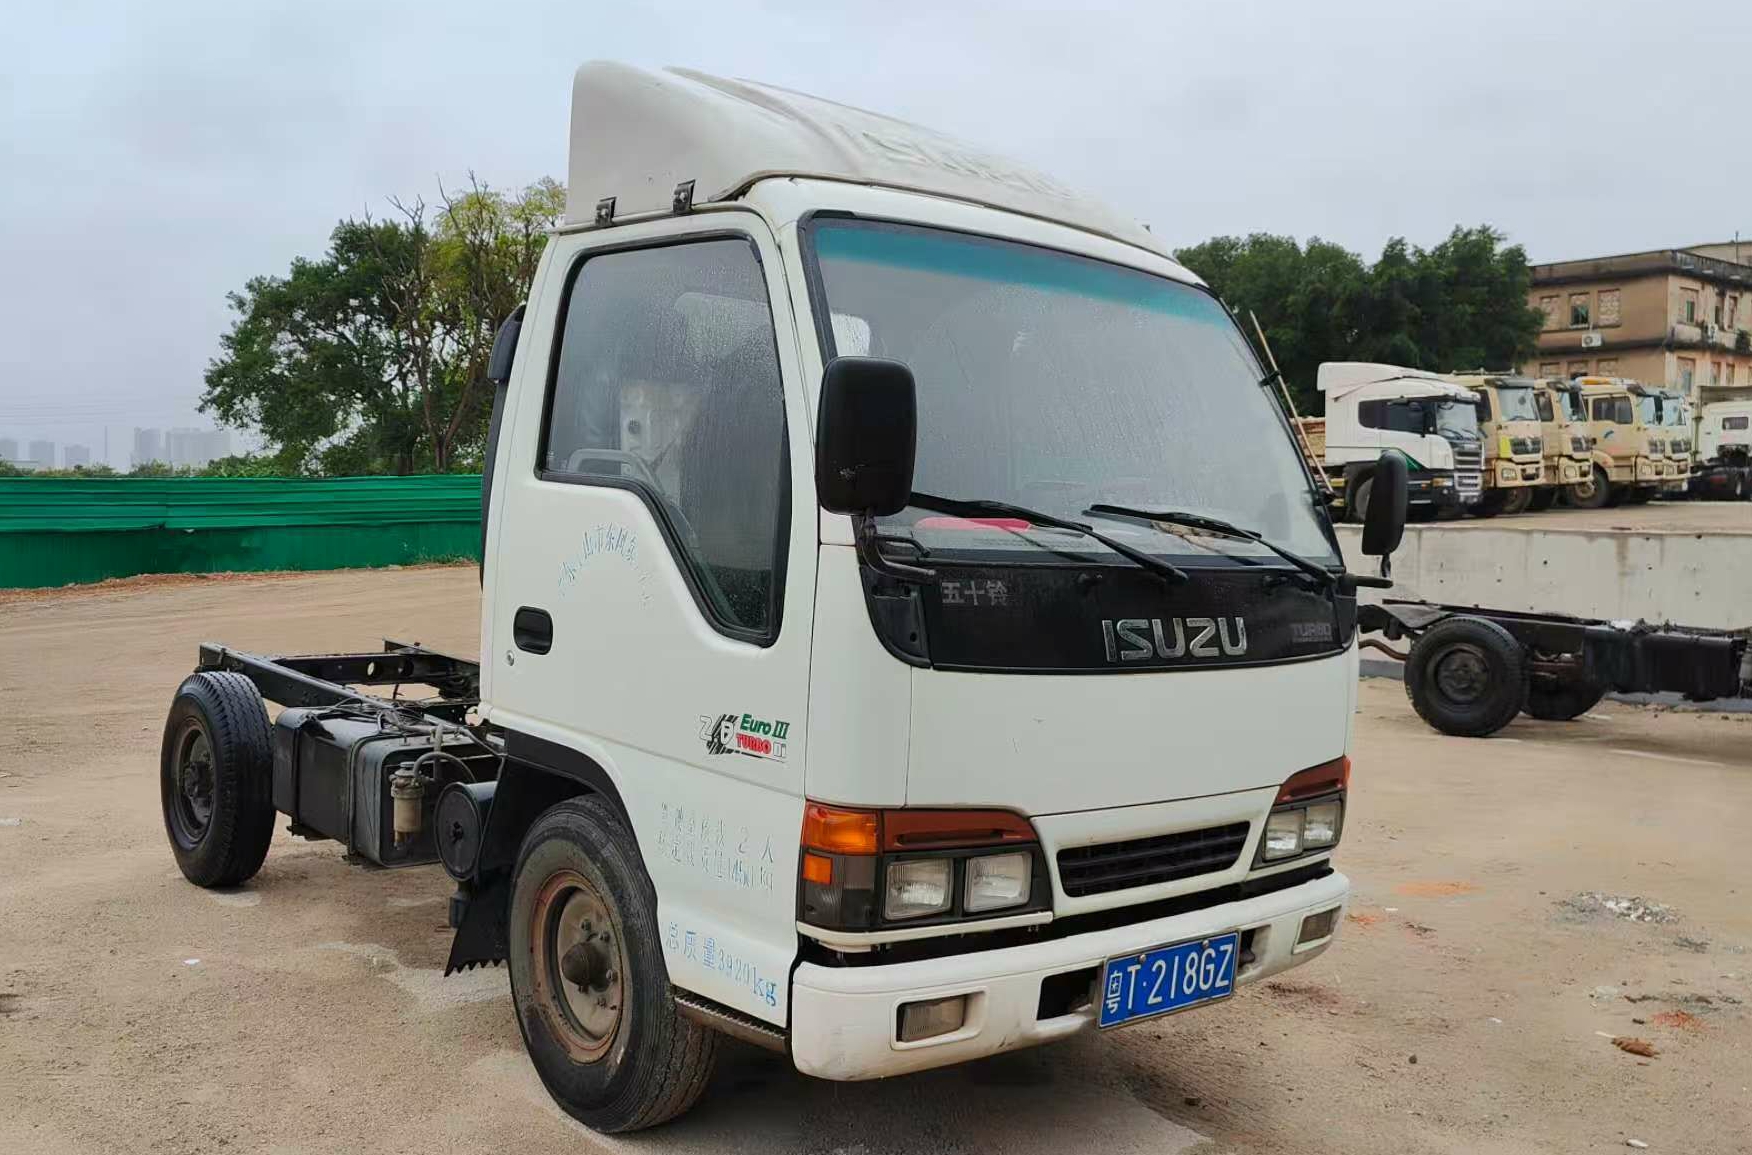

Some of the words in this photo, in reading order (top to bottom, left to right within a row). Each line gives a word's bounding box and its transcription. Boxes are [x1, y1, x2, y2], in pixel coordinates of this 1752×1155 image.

[1102, 617, 1247, 662] ISUZU
[740, 713, 772, 735] Euro
[735, 732, 772, 755] TURBO
